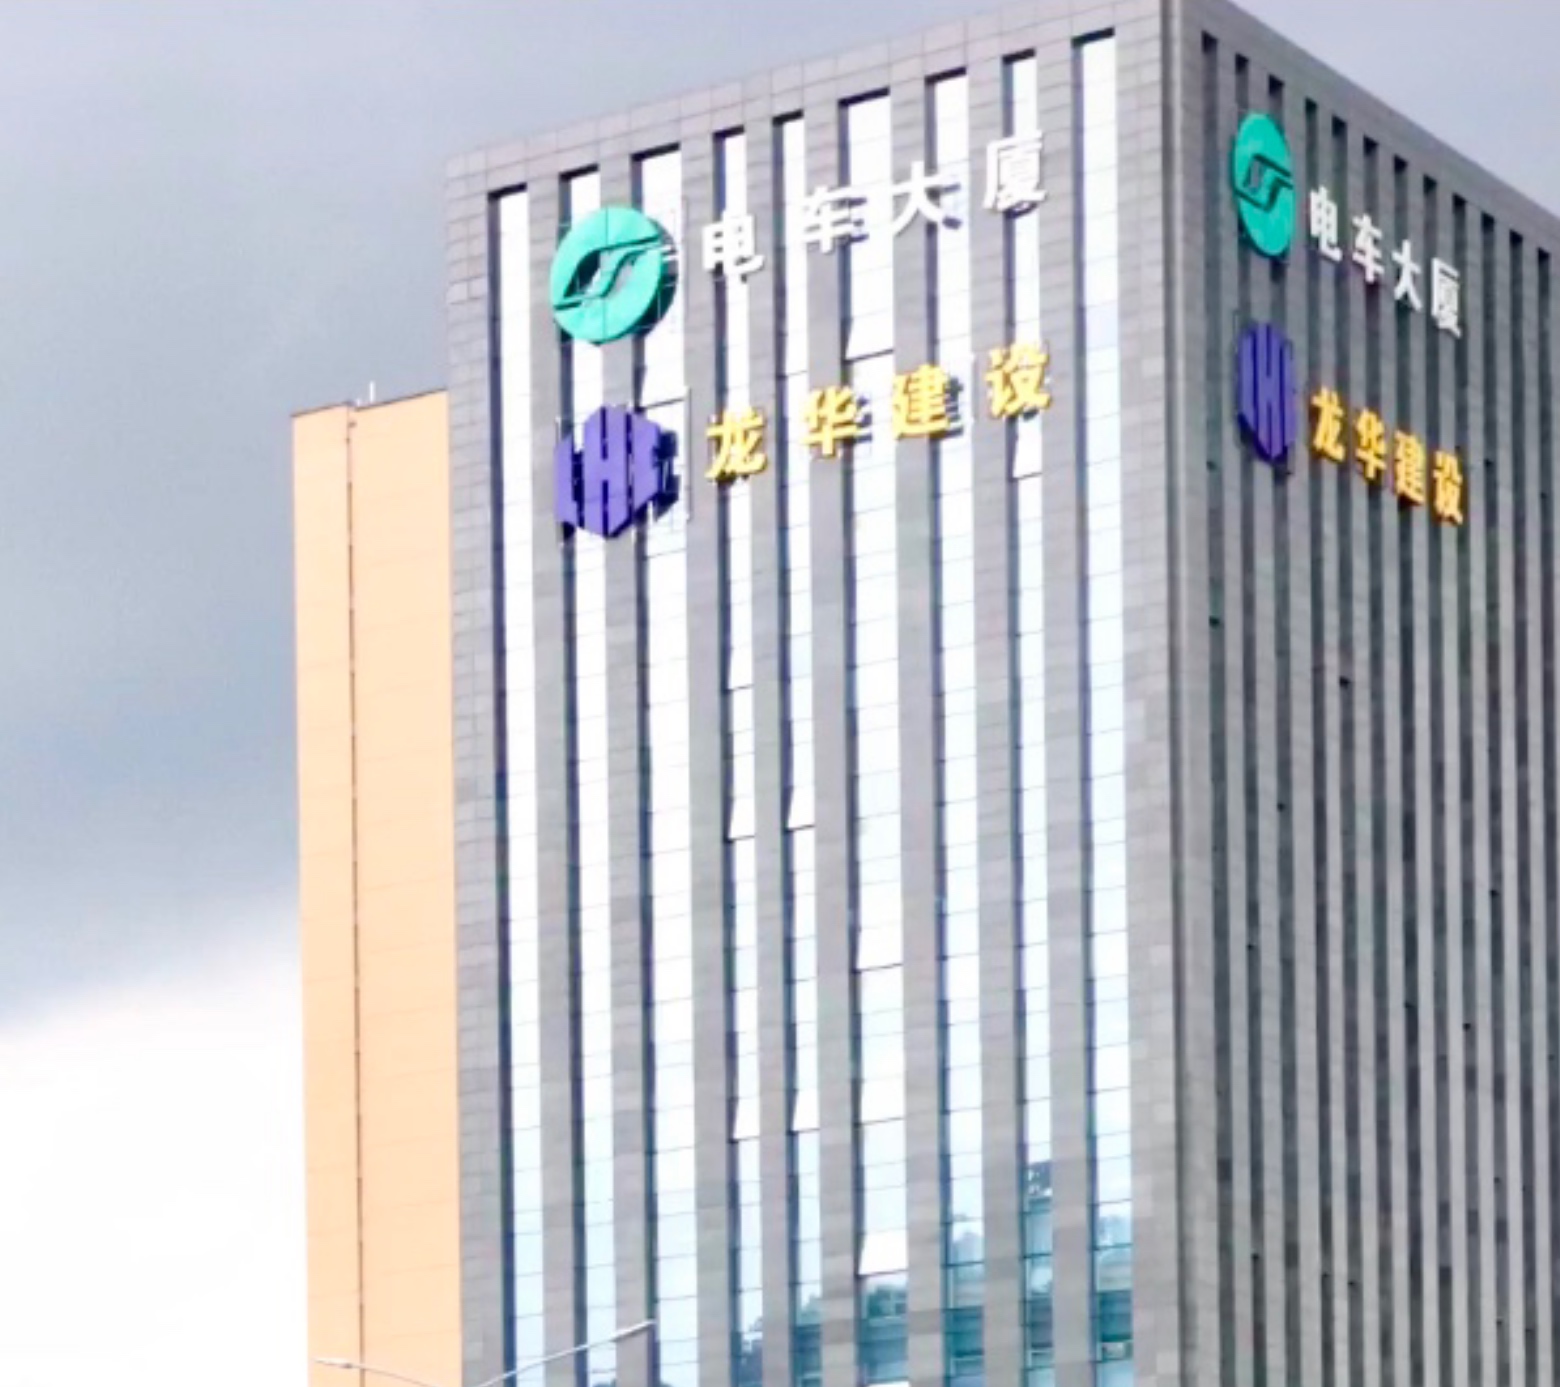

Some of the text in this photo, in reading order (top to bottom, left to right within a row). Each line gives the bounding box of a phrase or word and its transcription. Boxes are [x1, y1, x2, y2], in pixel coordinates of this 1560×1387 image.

[702, 130, 1046, 278] 电车大厦
[1310, 185, 1462, 340] 电车大厦
[706, 340, 1054, 480] 龙华建设
[1310, 385, 1464, 526] 龙华建设
